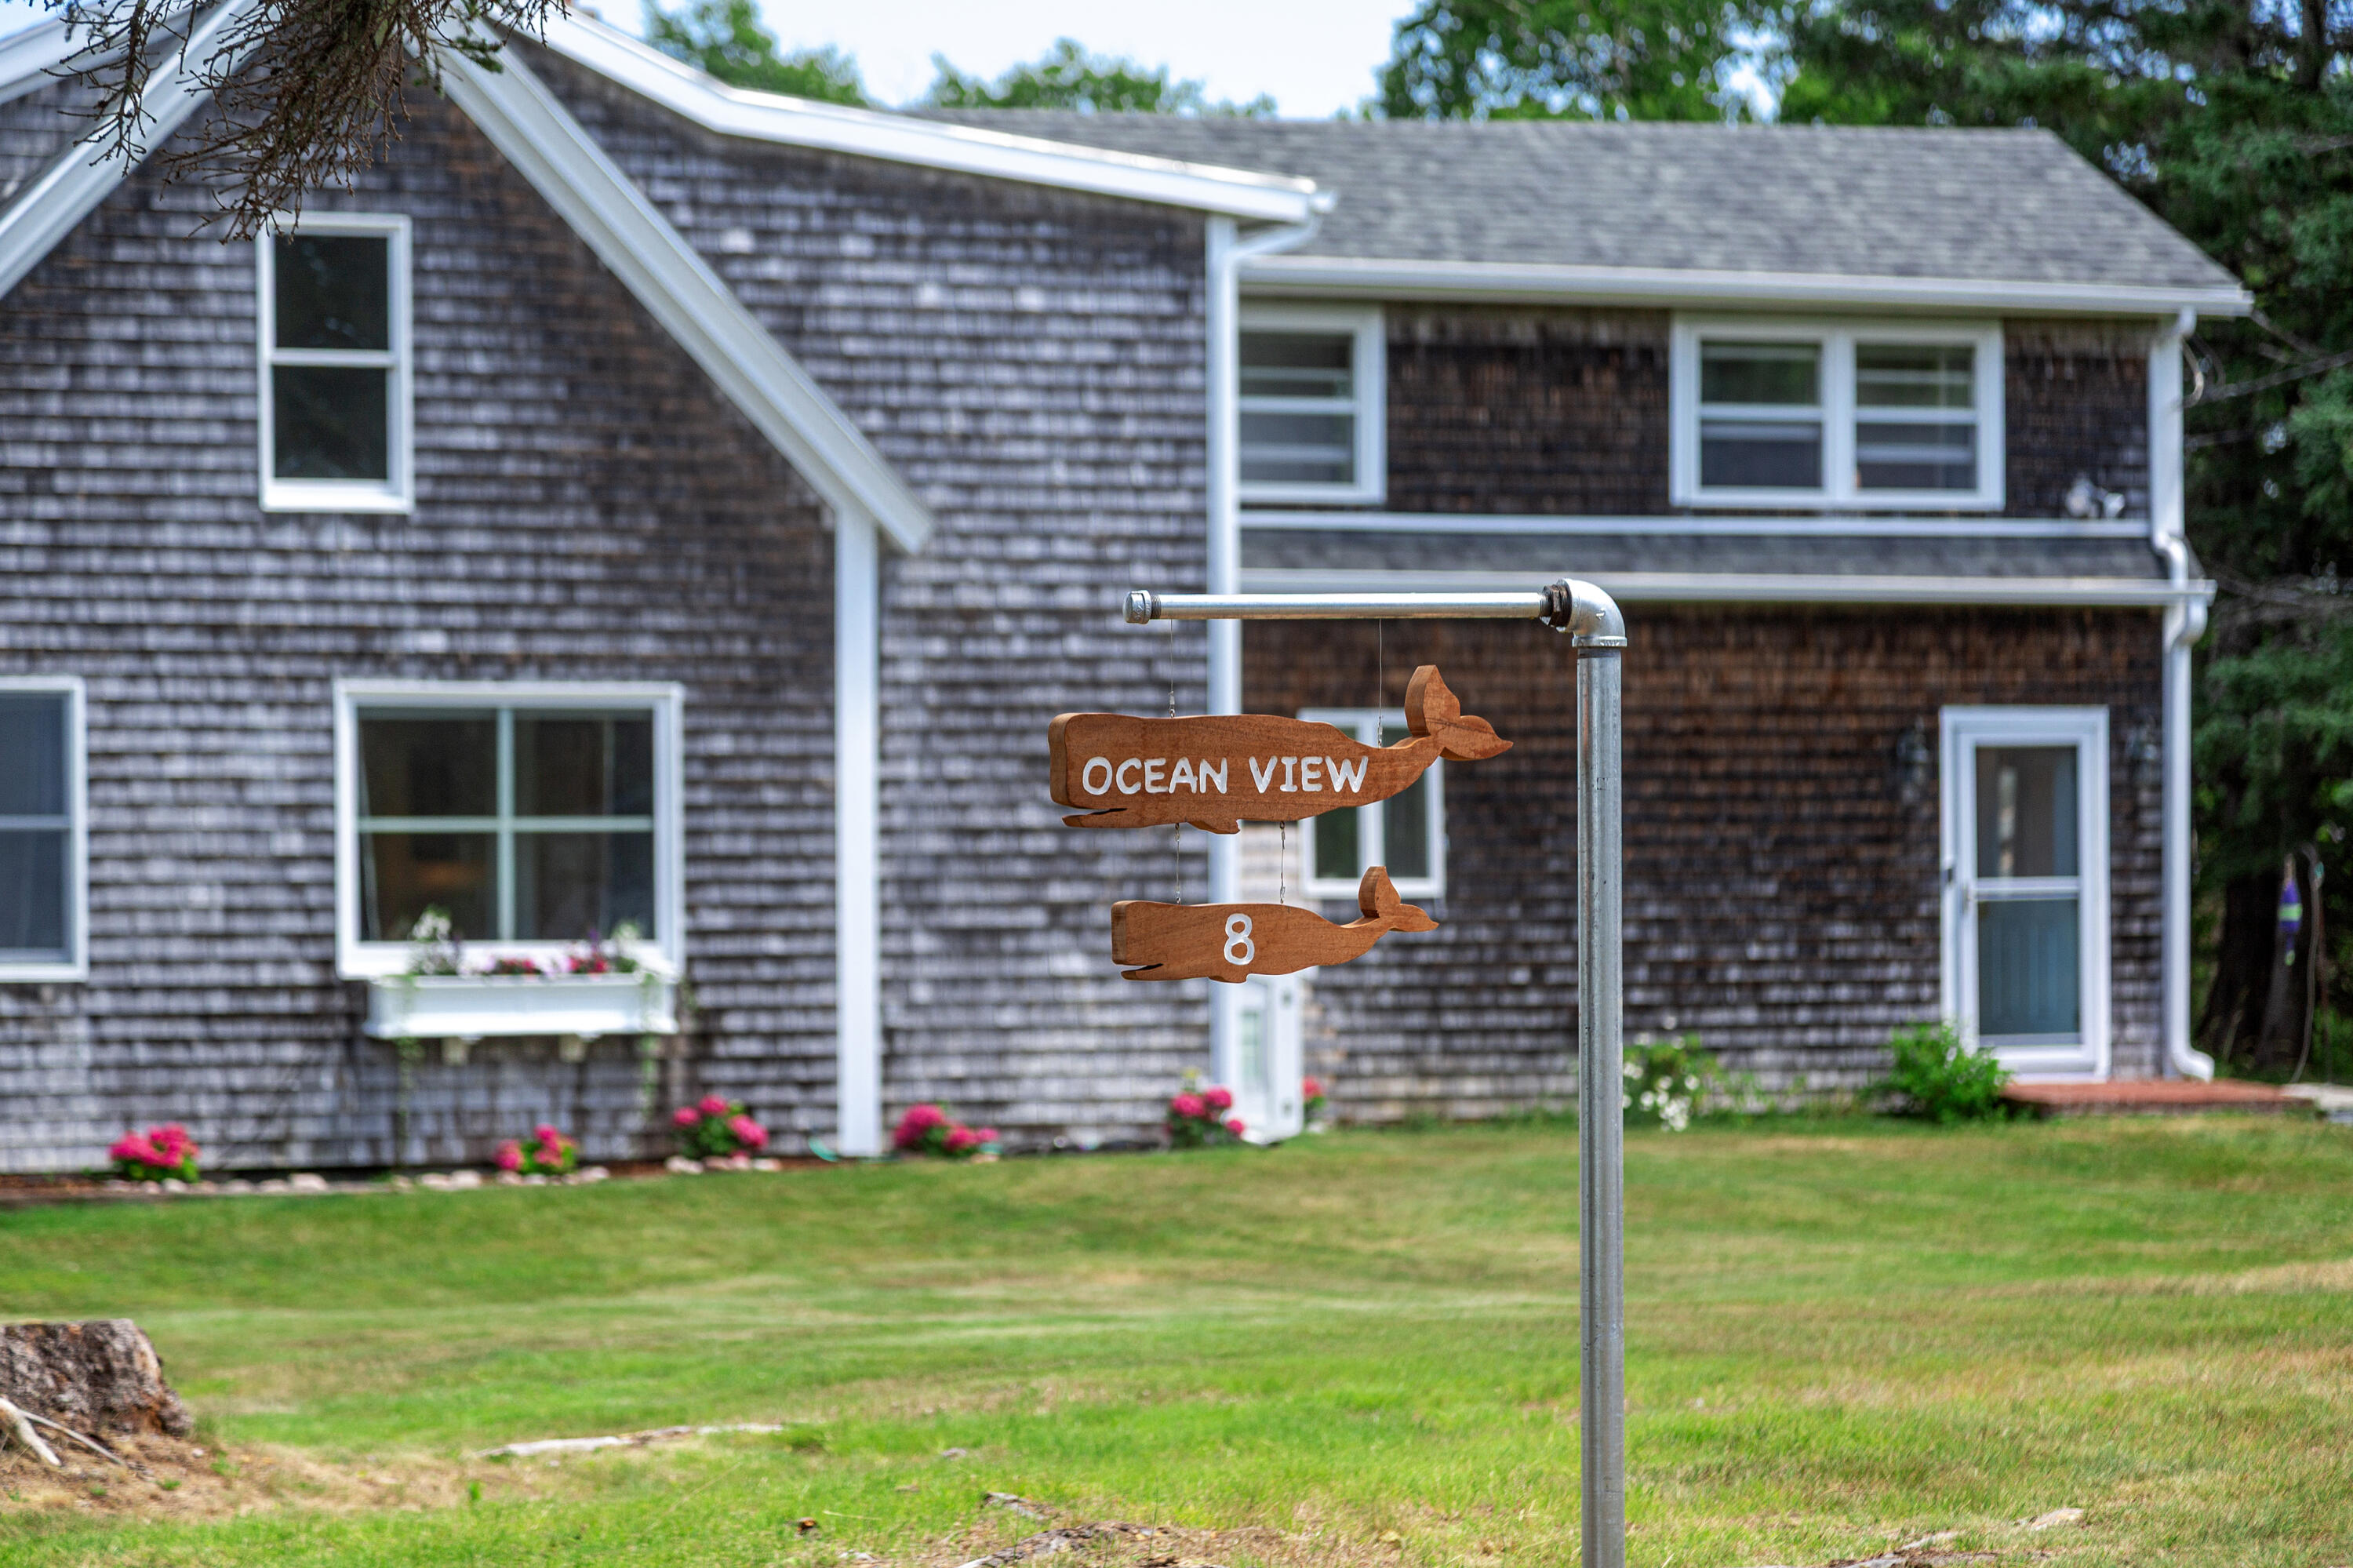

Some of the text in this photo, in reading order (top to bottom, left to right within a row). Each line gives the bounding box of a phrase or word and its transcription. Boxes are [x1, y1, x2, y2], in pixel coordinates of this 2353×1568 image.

[1082, 755, 1369, 795] OCEAN VIEW
[1224, 913, 1255, 966] 8
